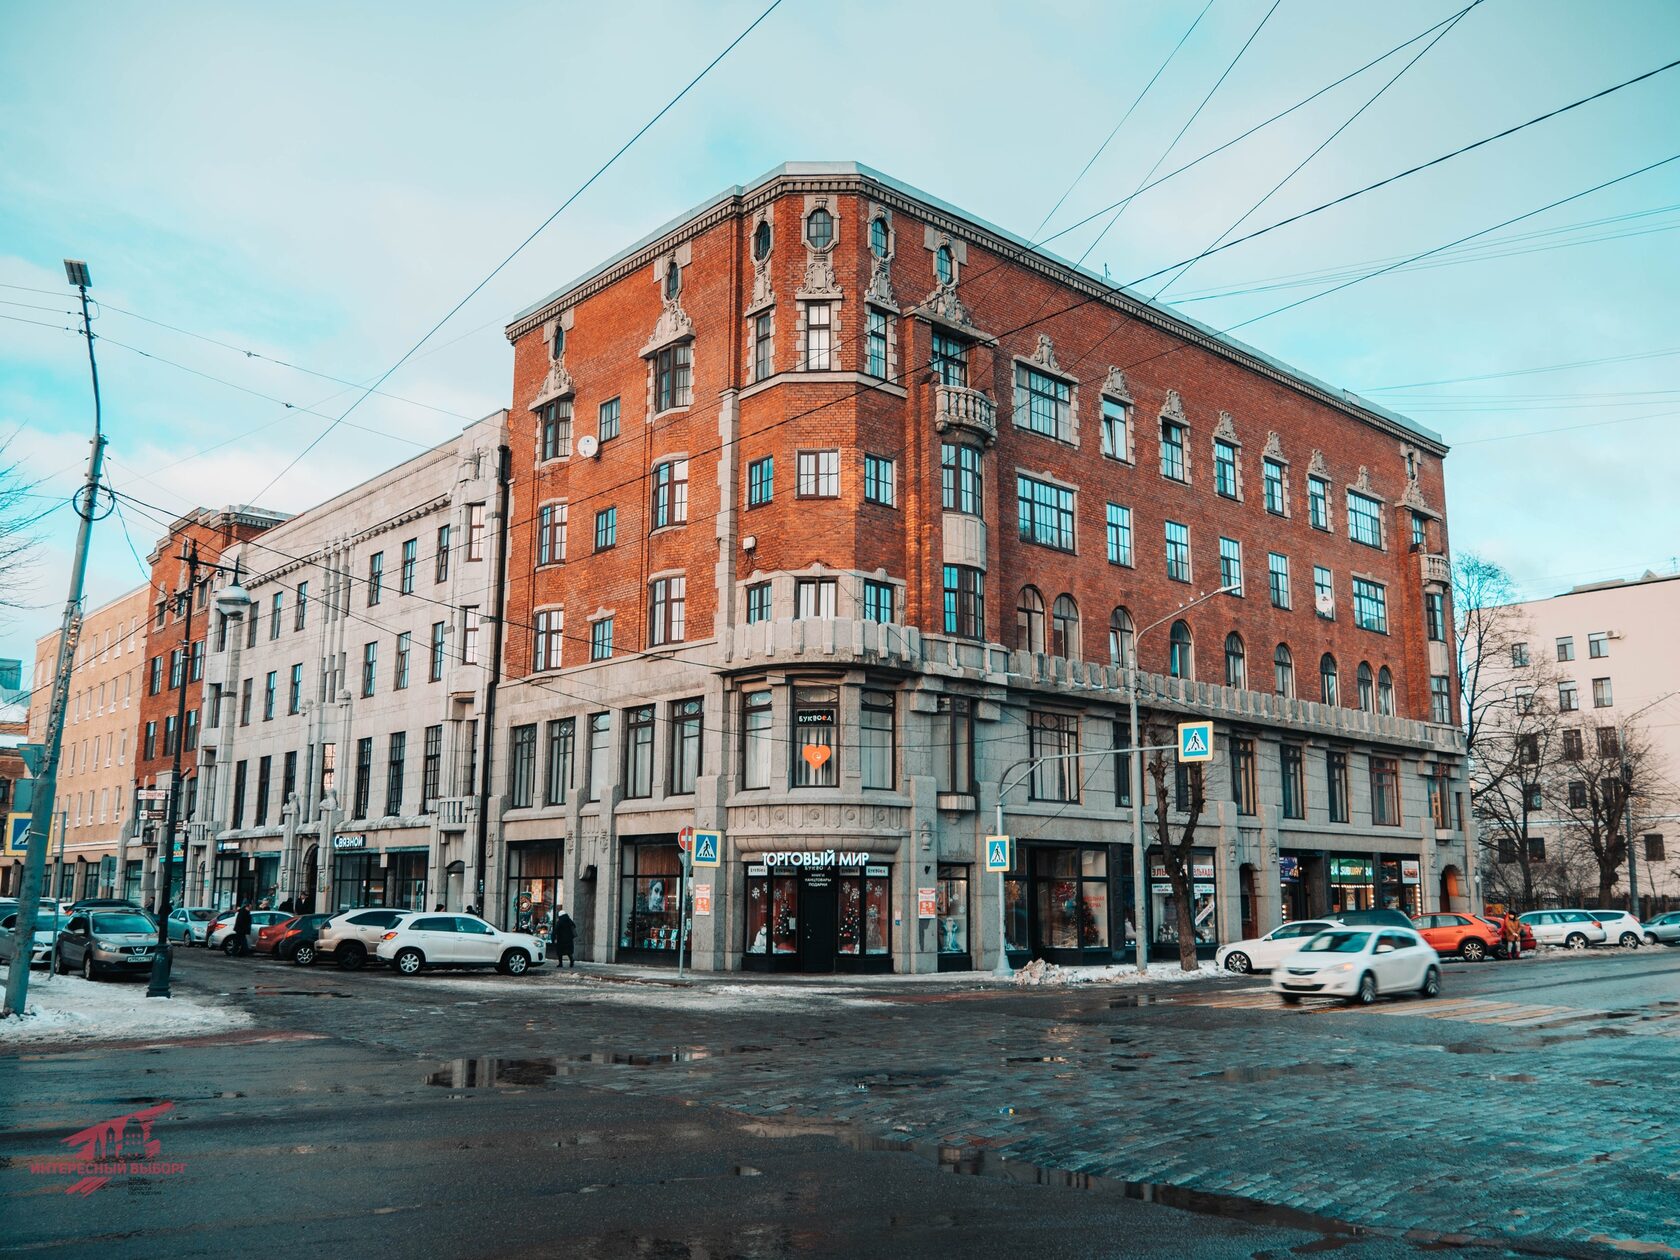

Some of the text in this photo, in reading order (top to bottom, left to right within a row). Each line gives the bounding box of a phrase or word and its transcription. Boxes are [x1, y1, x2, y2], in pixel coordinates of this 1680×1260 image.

[762, 849, 870, 867] ТОРГОВЫЙ МИР
[1330, 865, 1339, 876] 24
[1339, 866, 1363, 876] SUBWAY
[1364, 866, 1373, 877] 24
